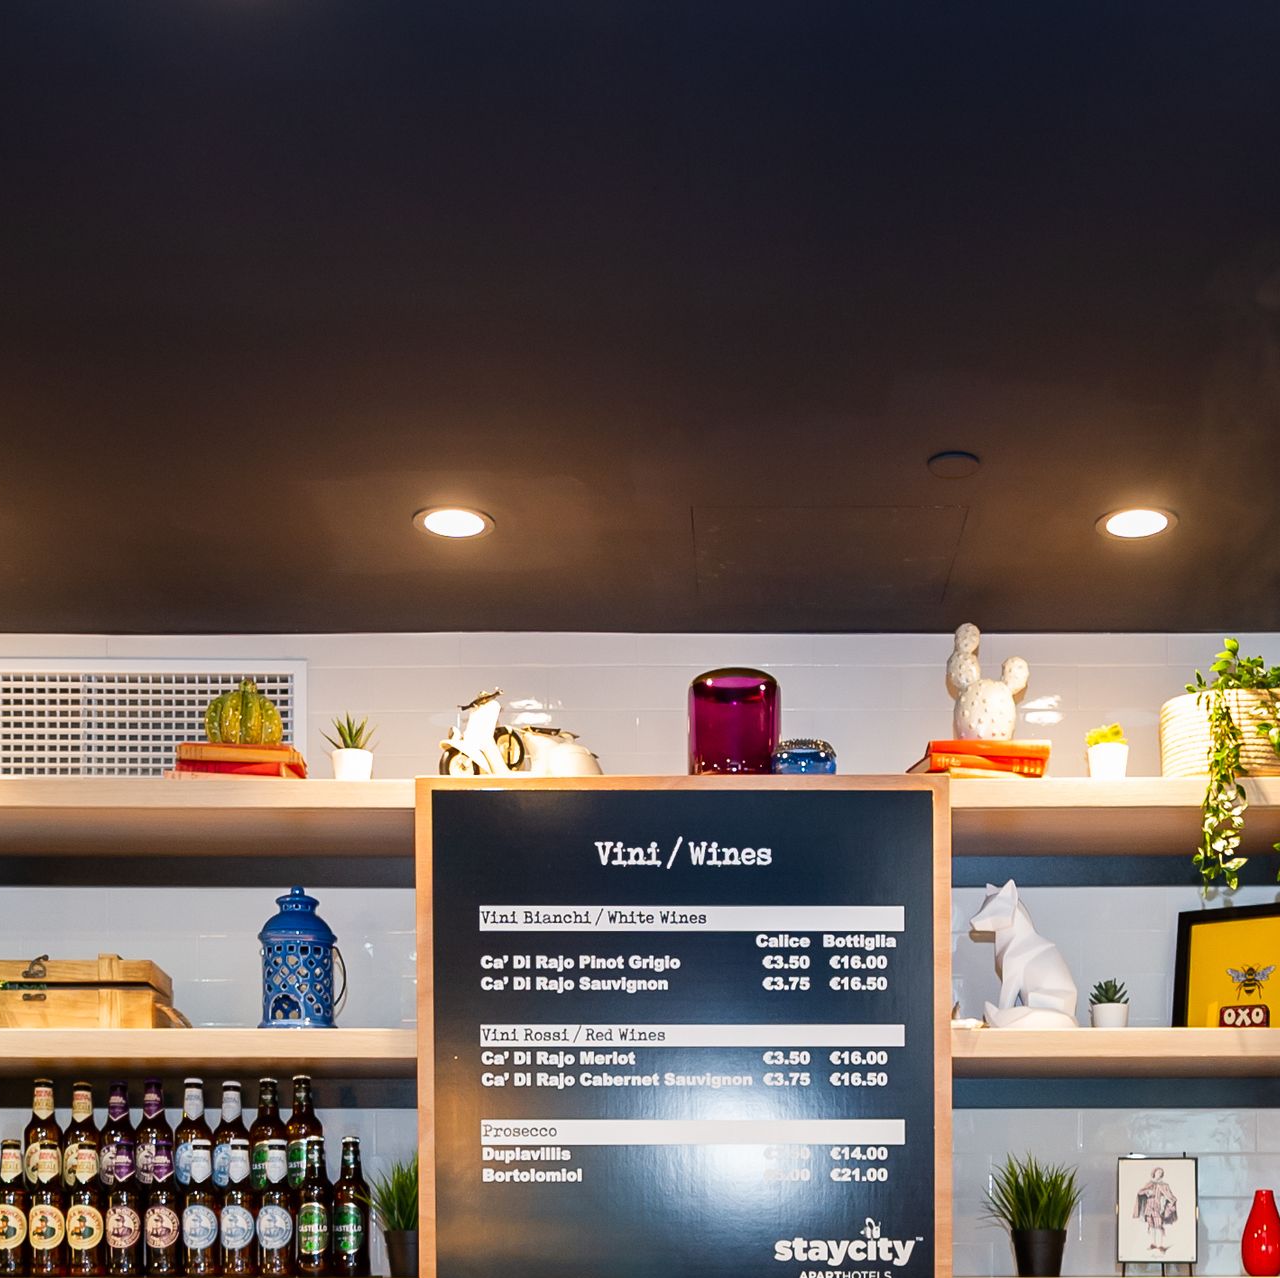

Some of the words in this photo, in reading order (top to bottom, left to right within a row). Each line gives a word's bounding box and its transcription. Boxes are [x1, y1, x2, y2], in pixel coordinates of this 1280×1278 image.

[593, 841, 662, 867] Vini
[666, 835, 683, 869] /
[687, 841, 772, 867] Wines
[480, 910, 518, 924] Vini
[523, 910, 591, 924] Bianchi
[594, 907, 603, 925] /
[607, 910, 654, 924] White
[659, 910, 706, 924] Wines
[755, 933, 810, 947] Calice
[822, 933, 896, 951] Bottiglia
[480, 954, 508, 969] Ca'
[512, 954, 530, 969] Di
[535, 954, 574, 972] Rajo
[578, 954, 624, 969] Pinot
[628, 954, 680, 972] Grigio
[761, 954, 810, 969] €3.50
[828, 954, 887, 969] €16.00
[480, 976, 508, 990] Ca'
[512, 976, 531, 990] Di
[535, 976, 574, 993] Rajo
[578, 976, 668, 993] Sauvignon
[761, 976, 810, 990] €3.75
[828, 976, 887, 990] €16.50
[1223, 1007, 1264, 1026] OXO
[481, 1028, 518, 1041] Vini
[523, 1027, 569, 1041] Rossi
[572, 1025, 581, 1042] /
[585, 1027, 613, 1041] Red
[618, 1028, 665, 1041] Wines
[480, 1050, 509, 1065] Ca'
[513, 1050, 531, 1065] Di
[536, 1050, 575, 1068] Rajo
[579, 1050, 635, 1065] Merlot
[762, 1051, 810, 1064] €3.50
[829, 1050, 887, 1064] €16.00
[481, 1072, 509, 1086] Ca'
[513, 1072, 531, 1086] Di
[536, 1072, 575, 1089] Rajo
[579, 1072, 659, 1086] Cabernet
[663, 1072, 754, 1089] Sauvignon
[762, 1072, 810, 1086] €3.75
[829, 1072, 887, 1086] €16.50
[482, 1123, 557, 1137] Prosecco
[481, 1146, 571, 1163] Duplavillis
[829, 1146, 887, 1160] €14.00
[482, 1167, 582, 1182] Bortolomiol
[829, 1167, 887, 1181] €21.00
[773, 1234, 915, 1266] staycity
